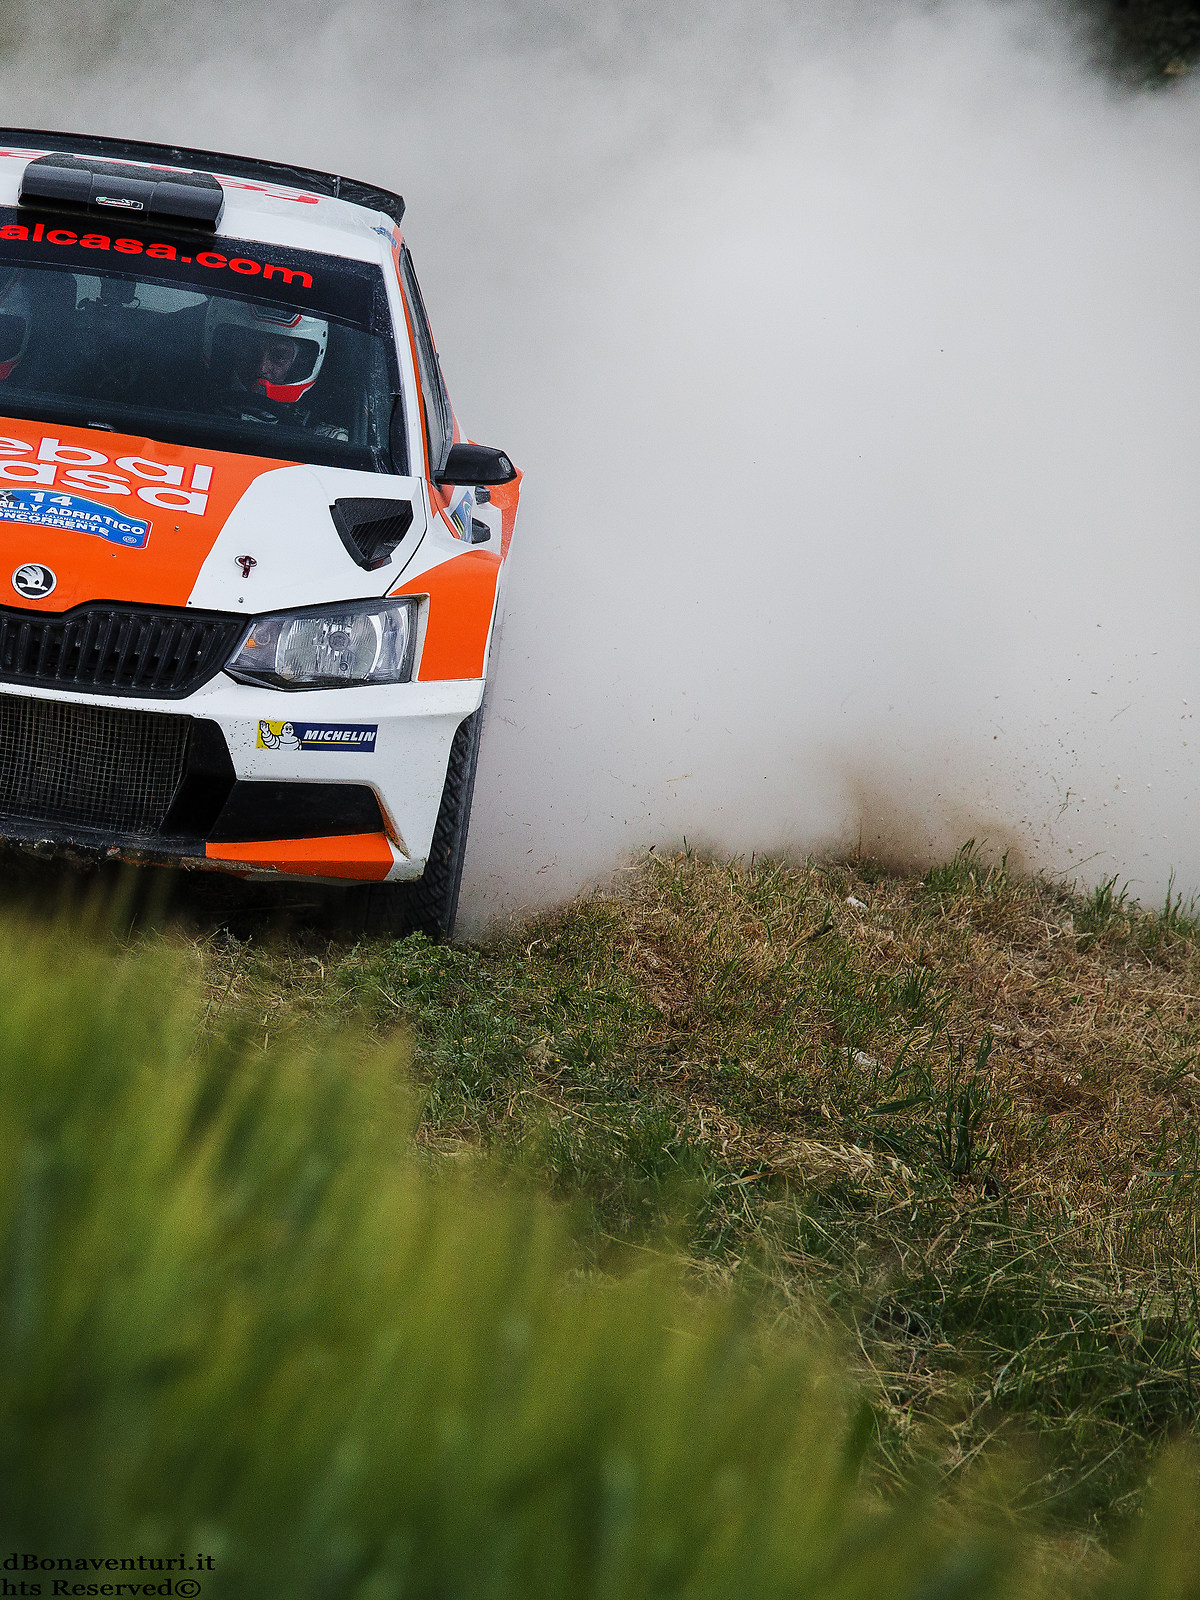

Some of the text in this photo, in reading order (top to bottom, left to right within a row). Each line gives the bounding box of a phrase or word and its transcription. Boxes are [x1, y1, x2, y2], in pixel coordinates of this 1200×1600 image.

[29, 491, 73, 507] 14
[45, 506, 145, 535] ADRIATICO
[303, 729, 376, 742] MICHELIN
